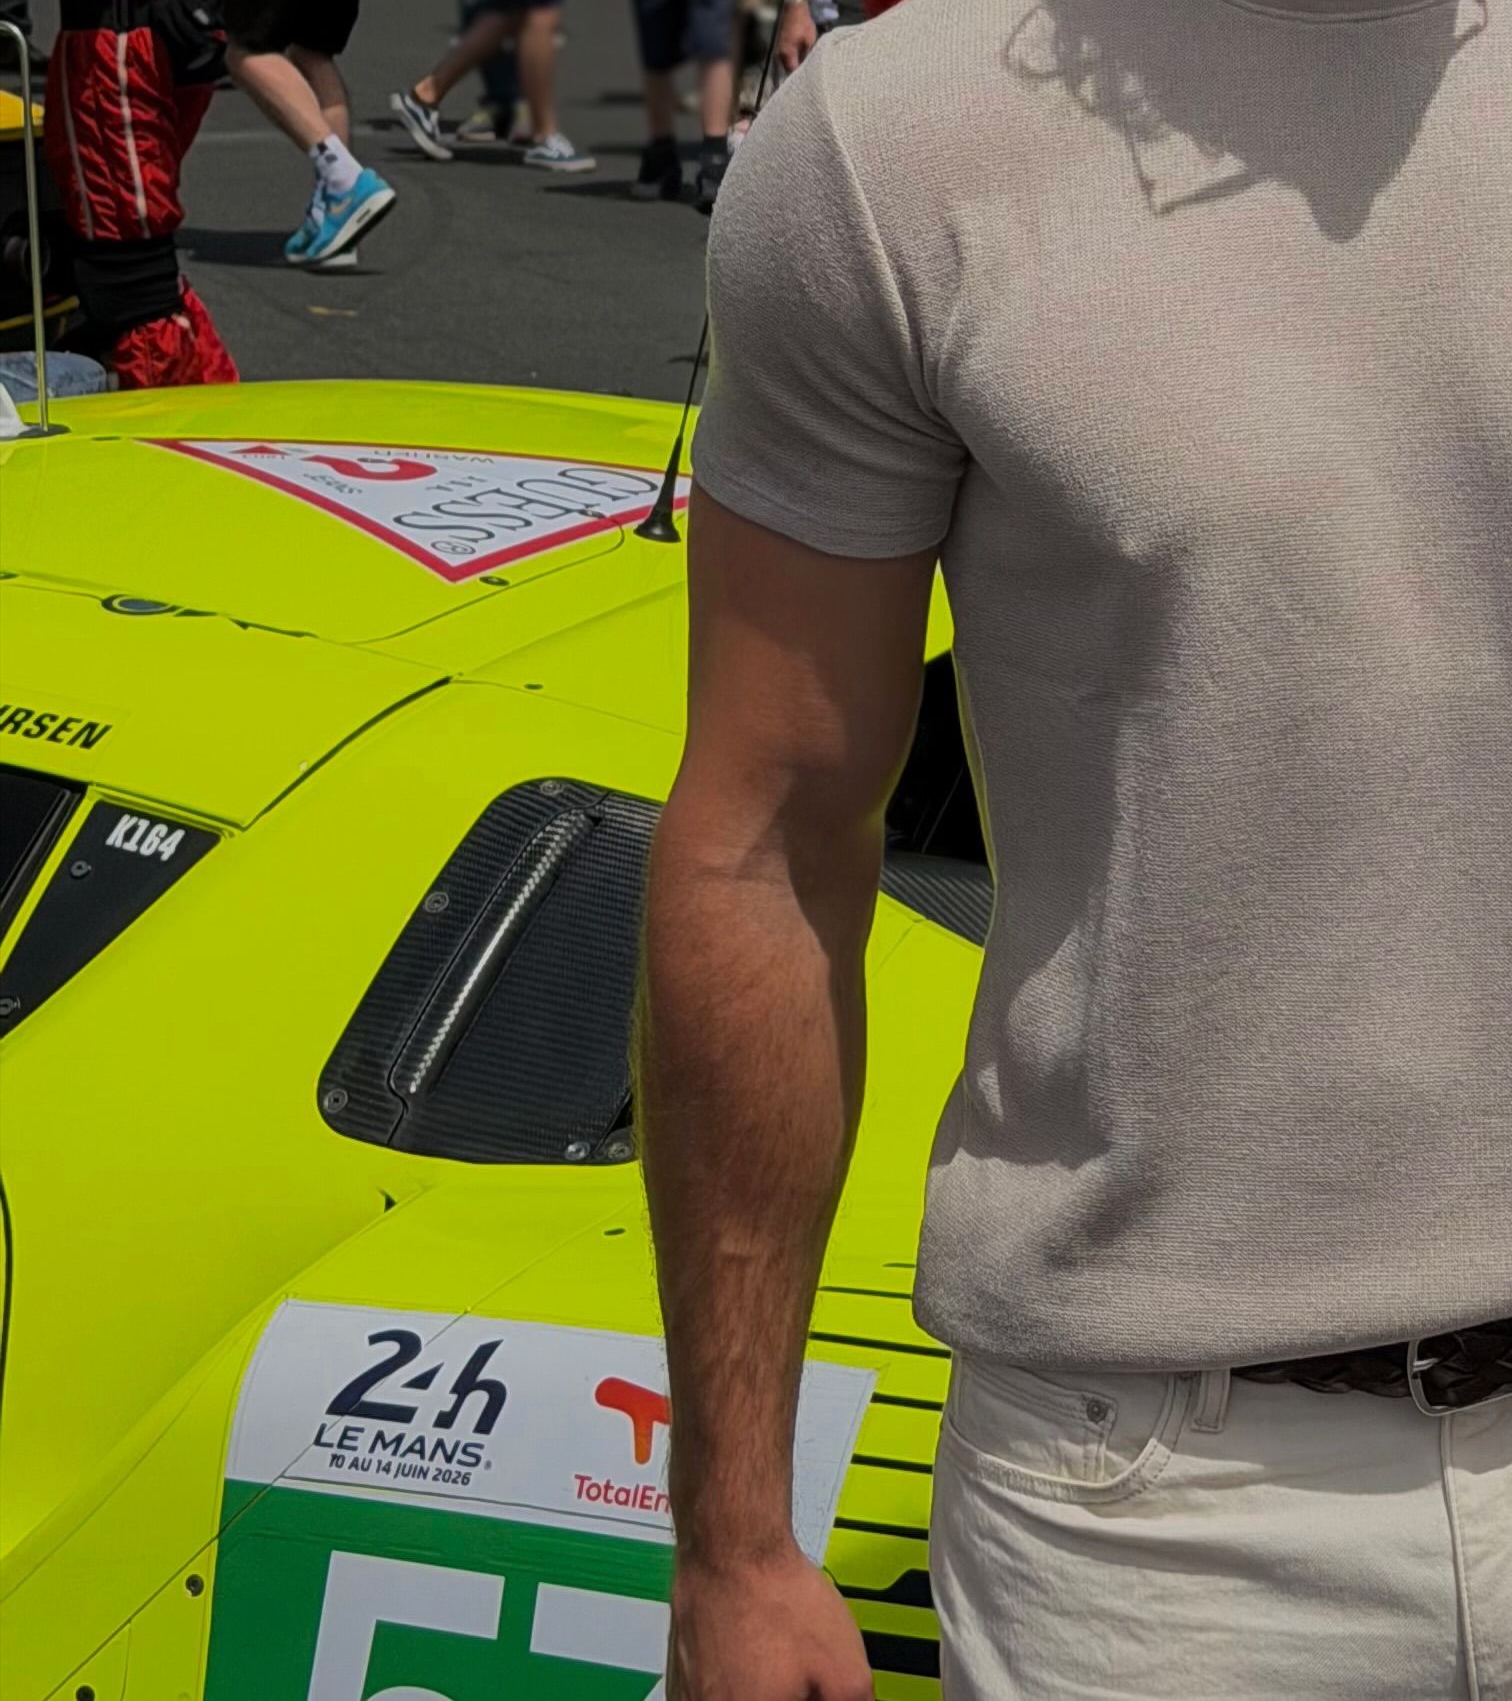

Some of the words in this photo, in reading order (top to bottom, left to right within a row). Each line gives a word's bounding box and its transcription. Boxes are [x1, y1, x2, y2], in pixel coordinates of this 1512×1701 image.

[392, 466, 659, 545] GUESS
[0, 704, 113, 750] RSEN
[105, 813, 186, 861] K164
[325, 1329, 507, 1435] 24h
[313, 1422, 365, 1451] LE
[368, 1429, 485, 1469] MANS
[329, 1453, 345, 1470] 10
[349, 1455, 371, 1472] AU
[376, 1459, 391, 1475] 14
[394, 1461, 428, 1482] JUIN
[432, 1467, 471, 1487] 2026
